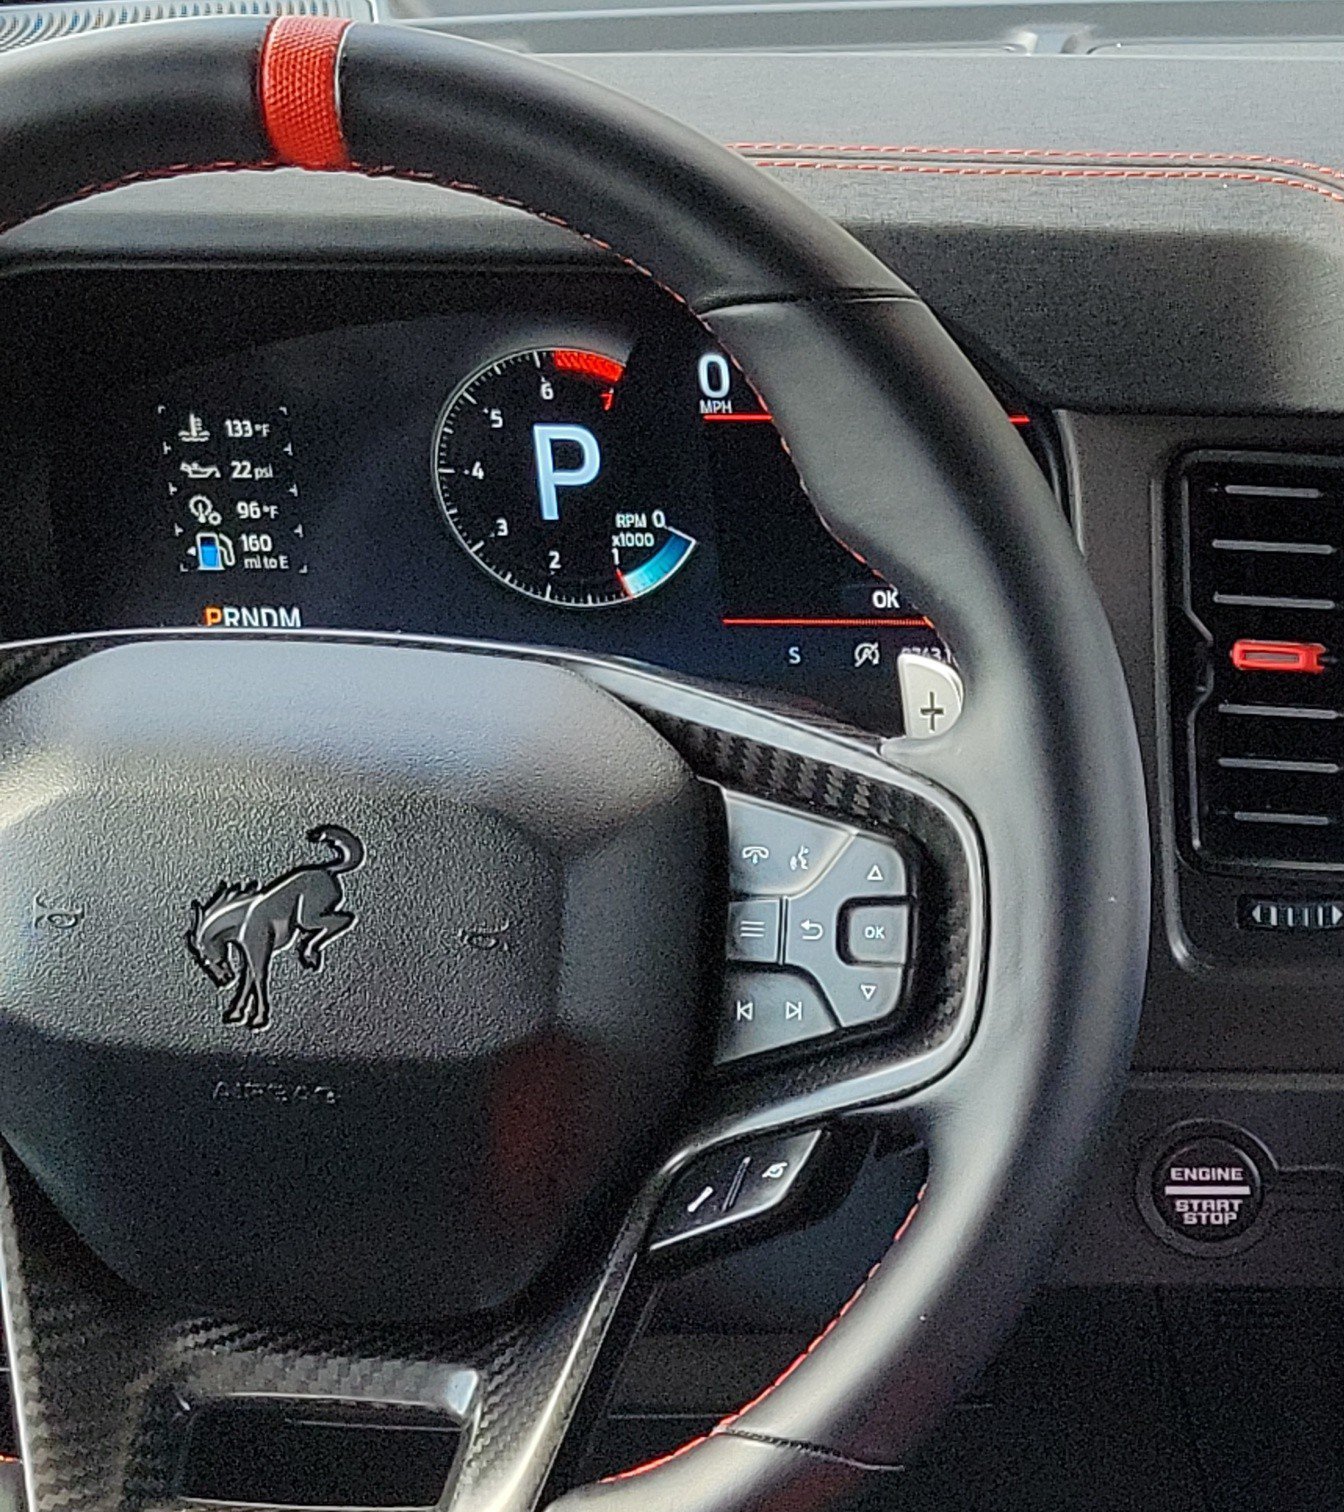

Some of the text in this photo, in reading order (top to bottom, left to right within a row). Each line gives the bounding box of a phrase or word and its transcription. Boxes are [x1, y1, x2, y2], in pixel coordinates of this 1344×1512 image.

[698, 353, 731, 398] 0
[540, 383, 554, 400] 6
[700, 400, 733, 414] MPH
[490, 410, 504, 428] 5
[230, 461, 252, 479] 22
[471, 462, 485, 480] 4
[533, 423, 601, 520] P
[496, 519, 509, 537] 3
[615, 513, 647, 528] RPM
[652, 510, 666, 528] 0
[239, 534, 272, 552] 160
[548, 552, 562, 569] 2
[872, 589, 900, 609] OK
[788, 647, 801, 665] S
[864, 925, 886, 940] OK
[1169, 1166, 1244, 1181] ENGINE
[1175, 1199, 1244, 1212] START
[1182, 1212, 1238, 1225] STOP
